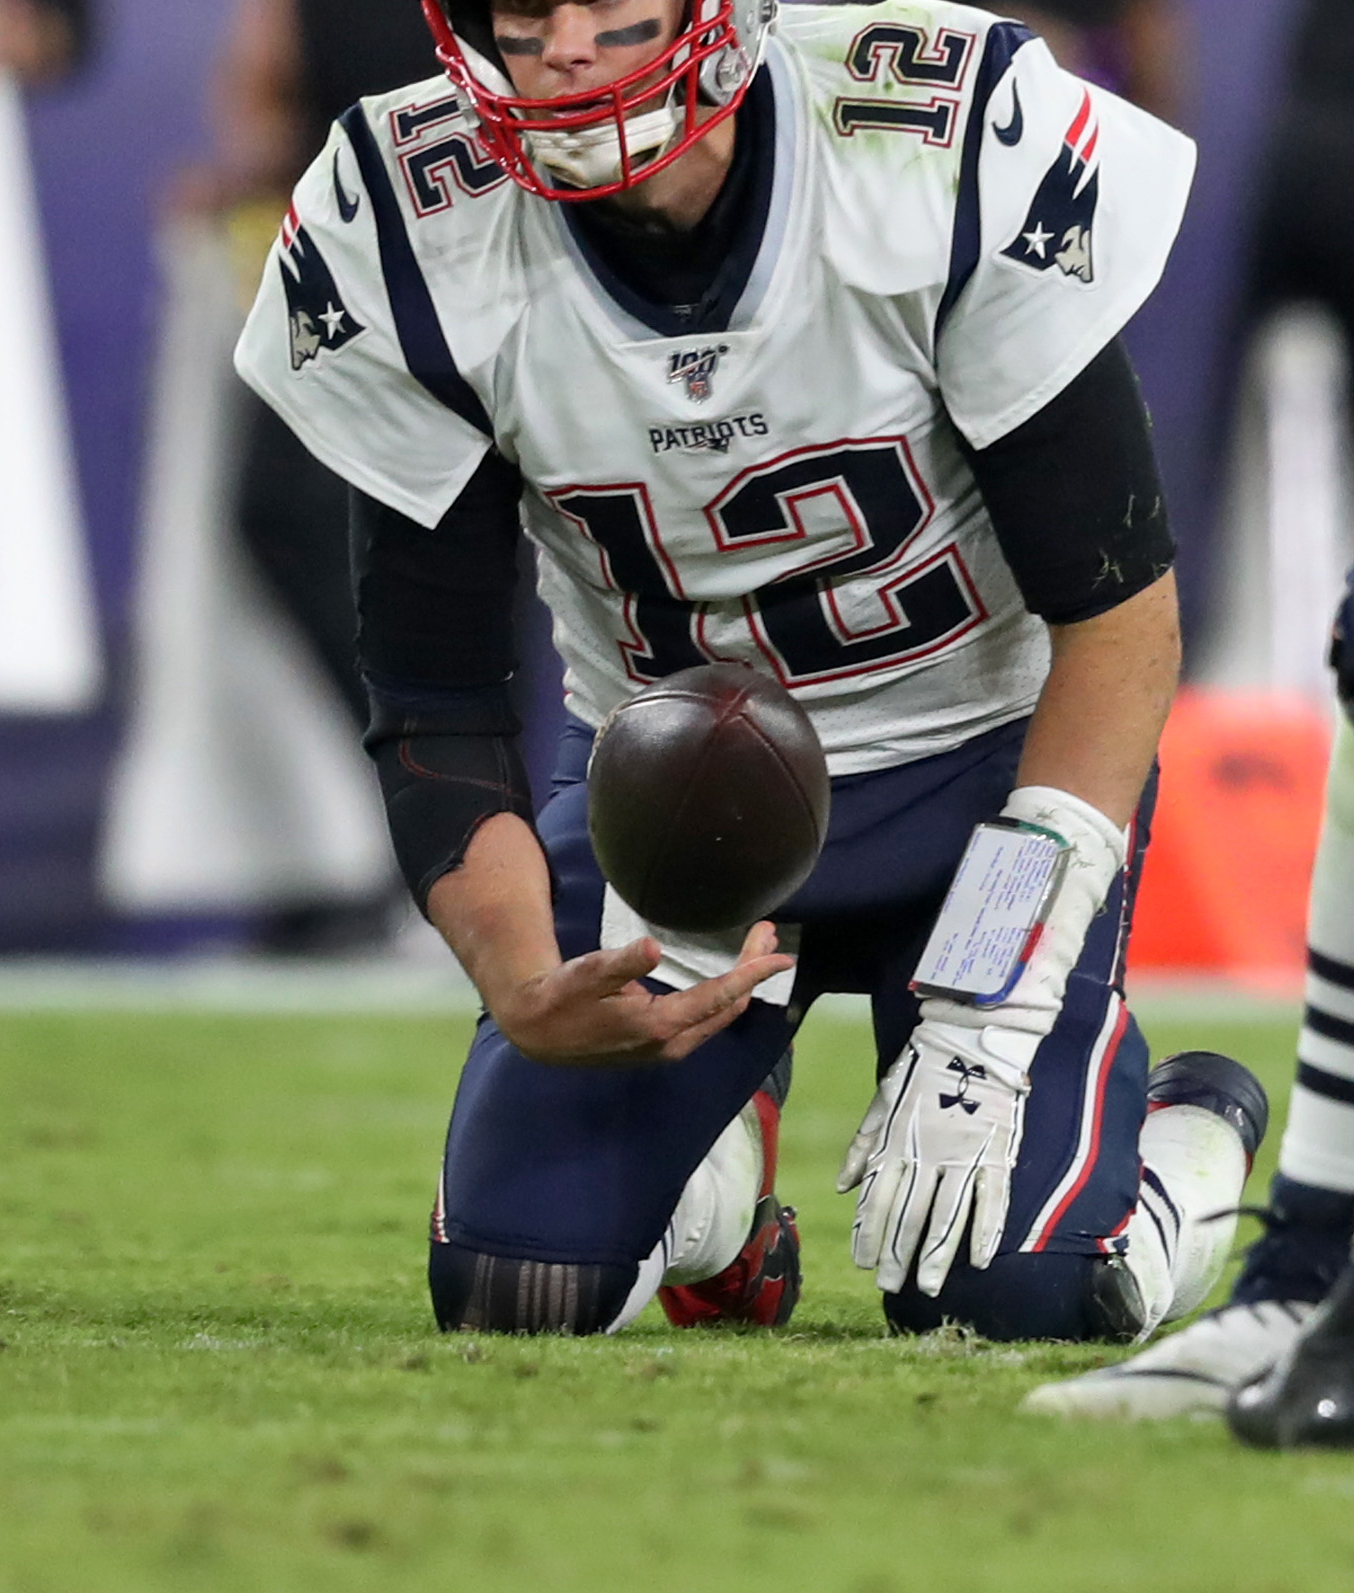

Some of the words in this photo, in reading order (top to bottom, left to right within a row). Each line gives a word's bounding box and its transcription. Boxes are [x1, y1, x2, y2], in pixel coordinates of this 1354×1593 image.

[832, 21, 977, 149] 12
[389, 93, 513, 219] 12
[647, 412, 769, 454] PATRIOTS
[545, 435, 989, 690] 12
